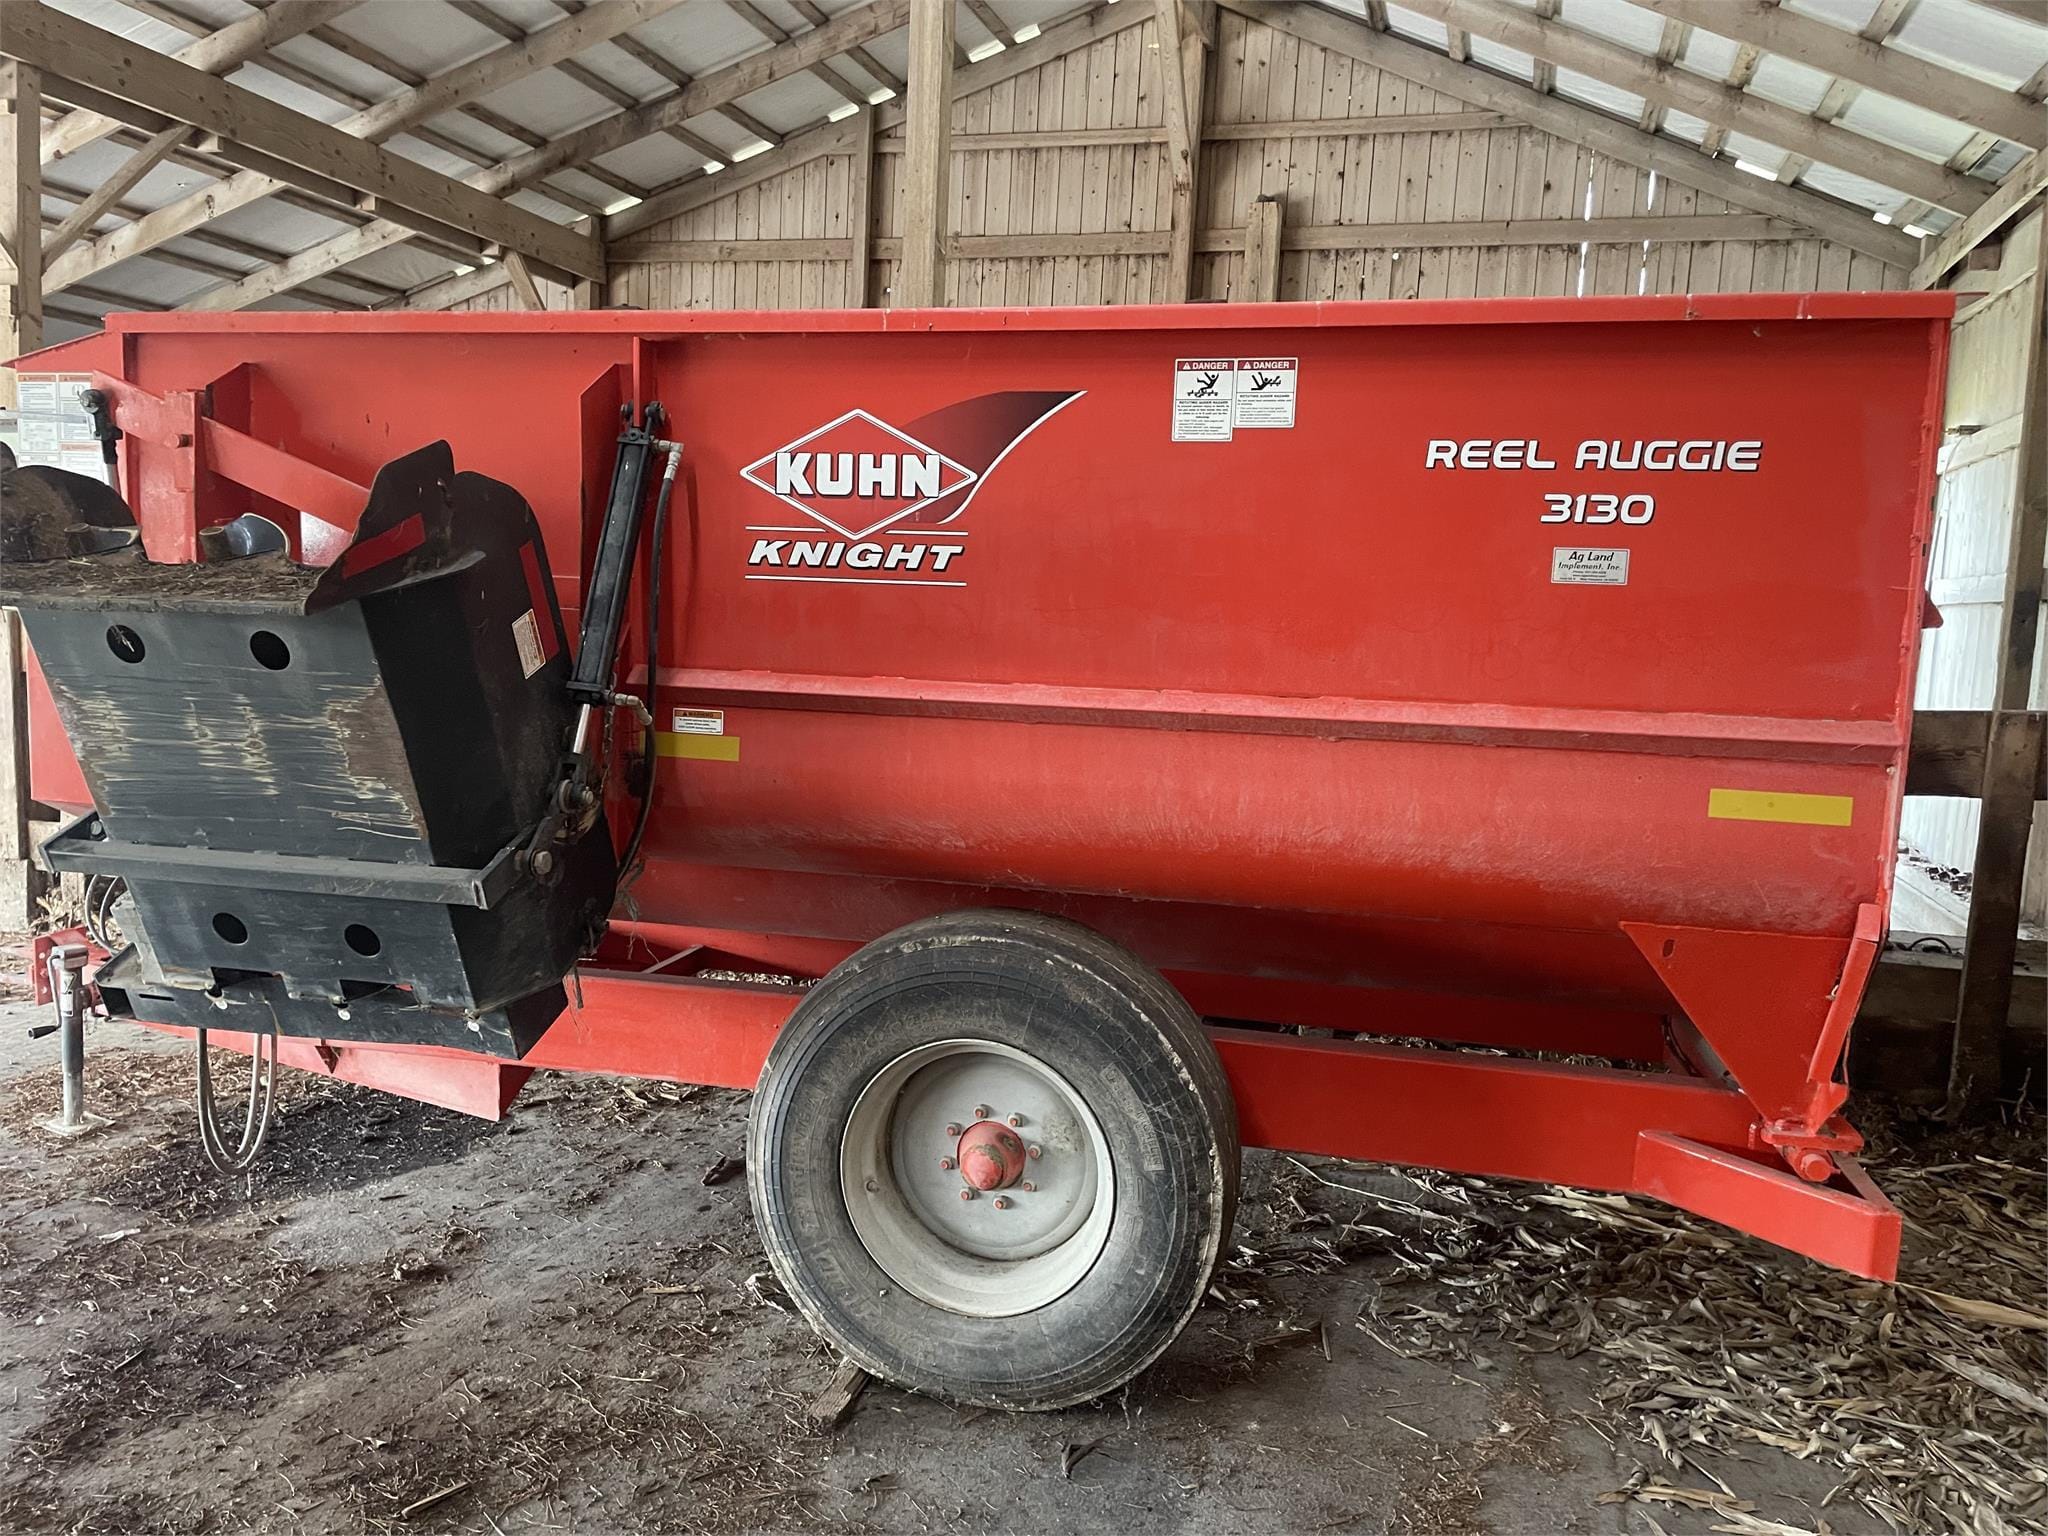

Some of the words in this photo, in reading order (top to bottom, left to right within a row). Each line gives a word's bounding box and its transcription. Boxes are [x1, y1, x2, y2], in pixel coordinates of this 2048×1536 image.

[1192, 362, 1229, 370] DANGER
[1253, 361, 1290, 369] DANGER
[1425, 439, 1556, 471] REEL
[1574, 440, 1763, 472] AUGGIE
[775, 452, 941, 499] KUHN
[1539, 493, 1656, 525] 3130
[748, 539, 964, 571] KNIGHT
[1569, 551, 1584, 563] Ag
[1588, 551, 1615, 562] Land
